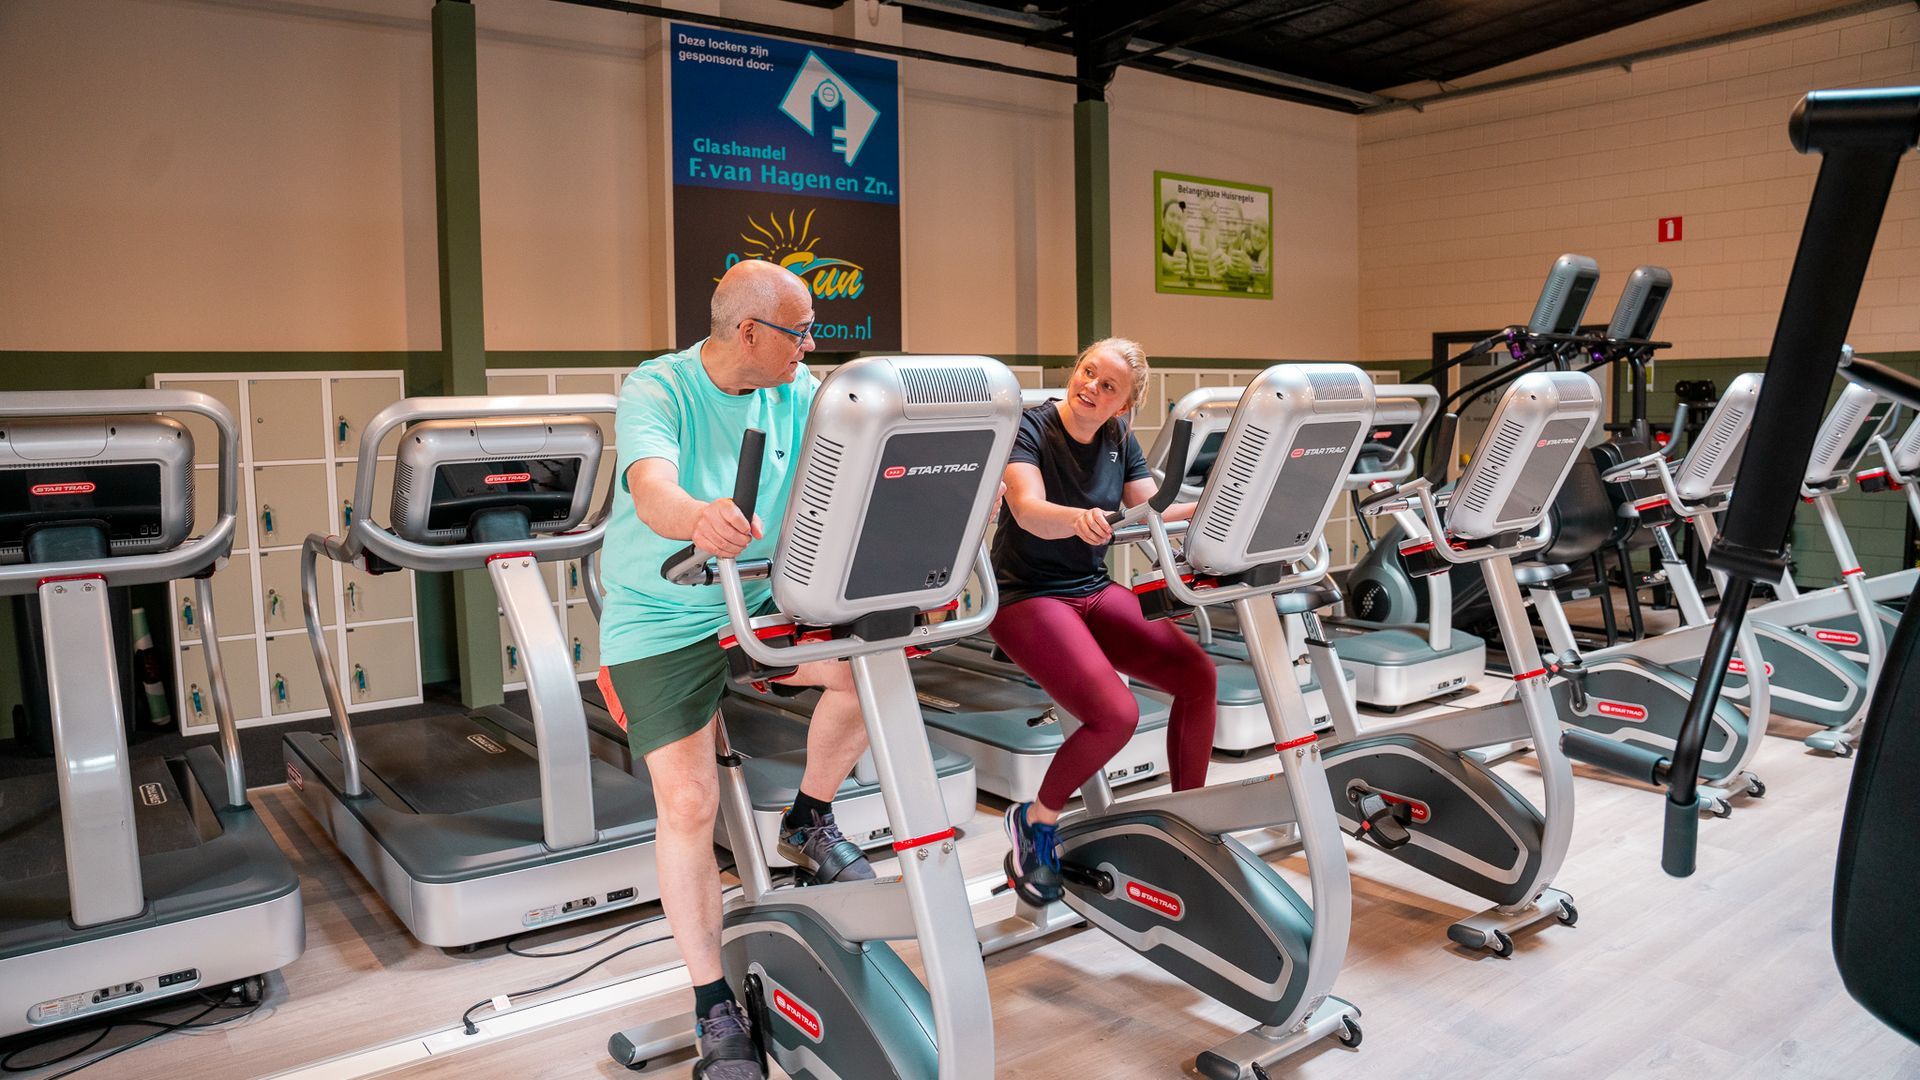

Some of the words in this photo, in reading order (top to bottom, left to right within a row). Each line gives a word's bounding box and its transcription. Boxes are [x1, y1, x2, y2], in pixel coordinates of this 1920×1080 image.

[679, 33, 706, 48] Deze
[709, 38, 748, 54] lockers
[750, 45, 769, 58] zijn
[678, 50, 744, 67] gesponsord
[746, 59, 774, 71] door:
[693, 138, 786, 161] Glashandel
[761, 164, 831, 191] Hagen
[835, 177, 859, 192] en
[864, 176, 894, 196] Zn.
[1177, 184, 1220, 198] Belangrijkste
[1221, 191, 1255, 204] Huisregels
[1304, 447, 1326, 456] STAR
[1325, 446, 1347, 454] TRAC
[907, 465, 942, 476] STAR
[944, 462, 979, 473] TRAC
[1141, 892, 1159, 904] STAR
[1158, 898, 1178, 911] TRAC
[786, 1003, 802, 1020] STAR
[801, 1014, 818, 1031] TRAC
